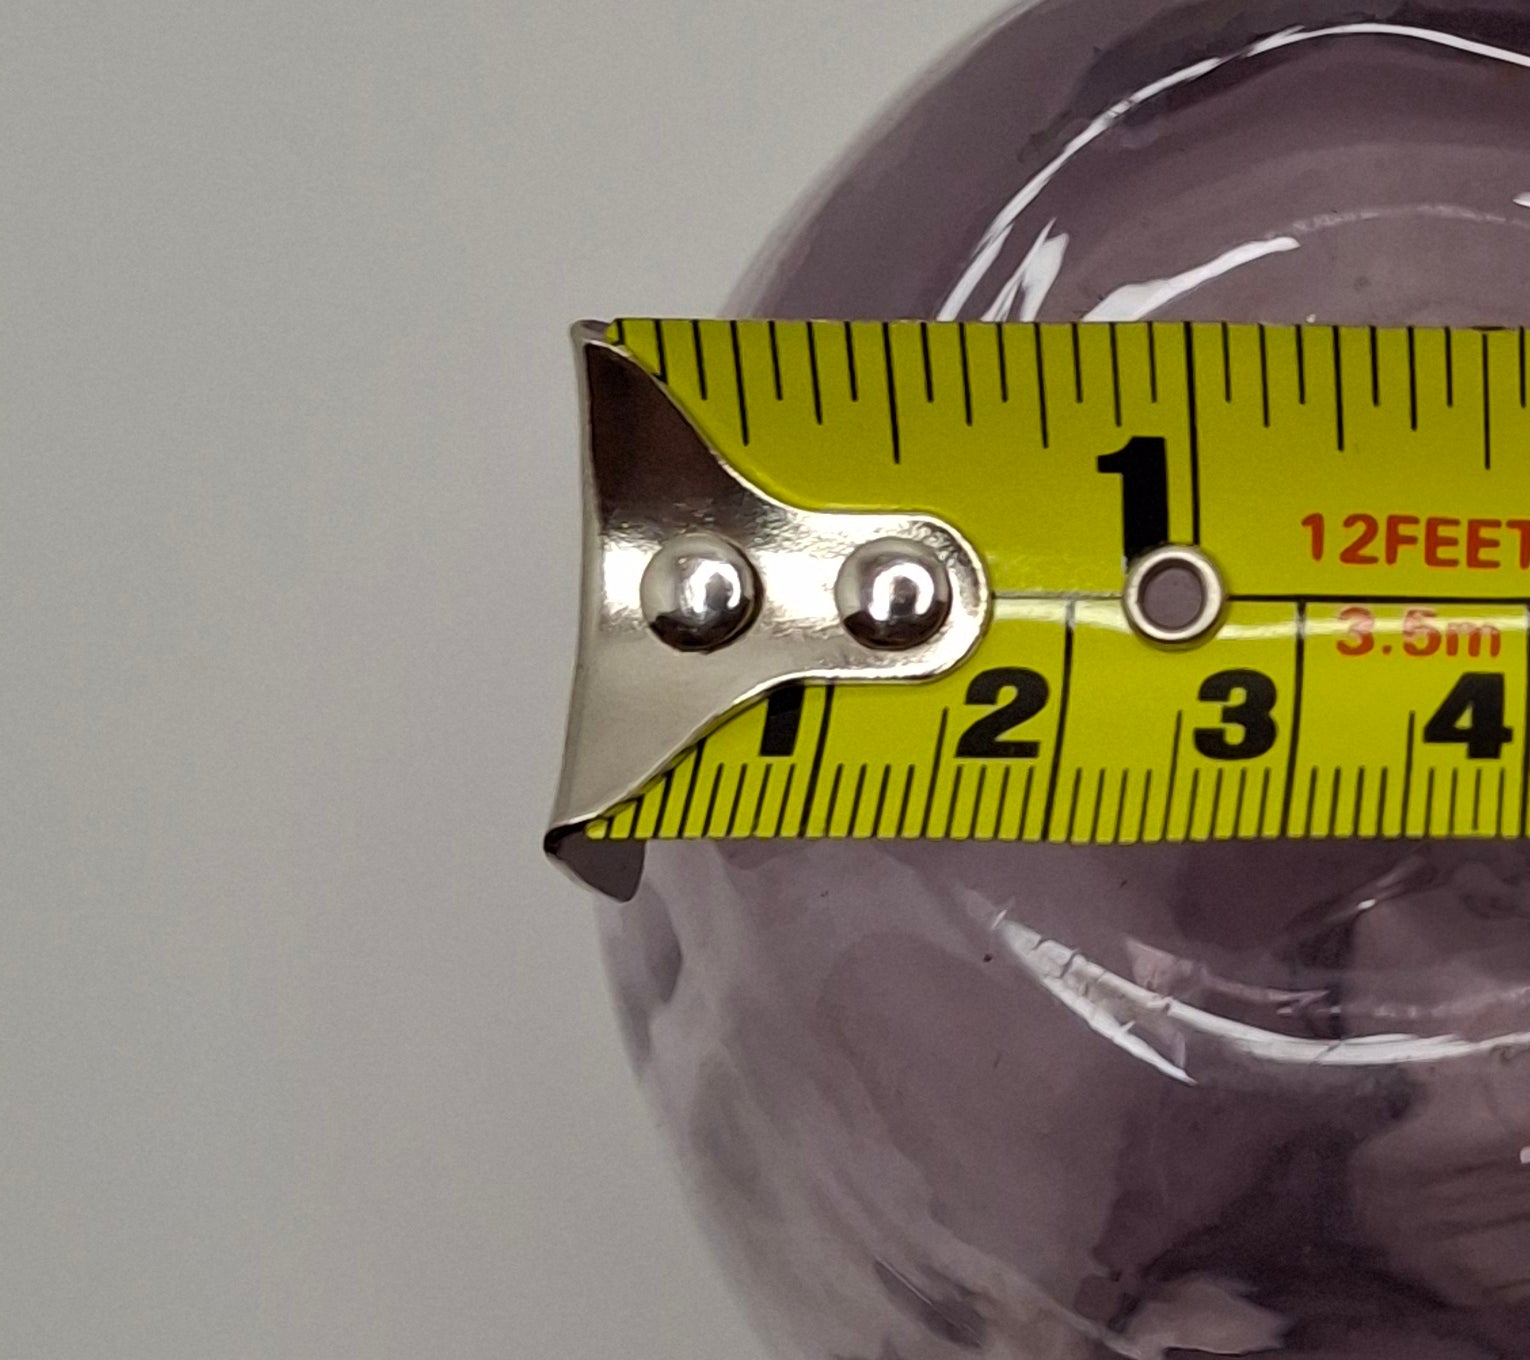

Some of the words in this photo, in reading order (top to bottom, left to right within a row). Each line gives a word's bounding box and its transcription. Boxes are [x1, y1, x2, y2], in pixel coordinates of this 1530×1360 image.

[1336, 606, 1501, 658] 3.5m
[955, 668, 1051, 759] 2
[1193, 671, 1279, 761] 3
[1423, 672, 1514, 759] 4
